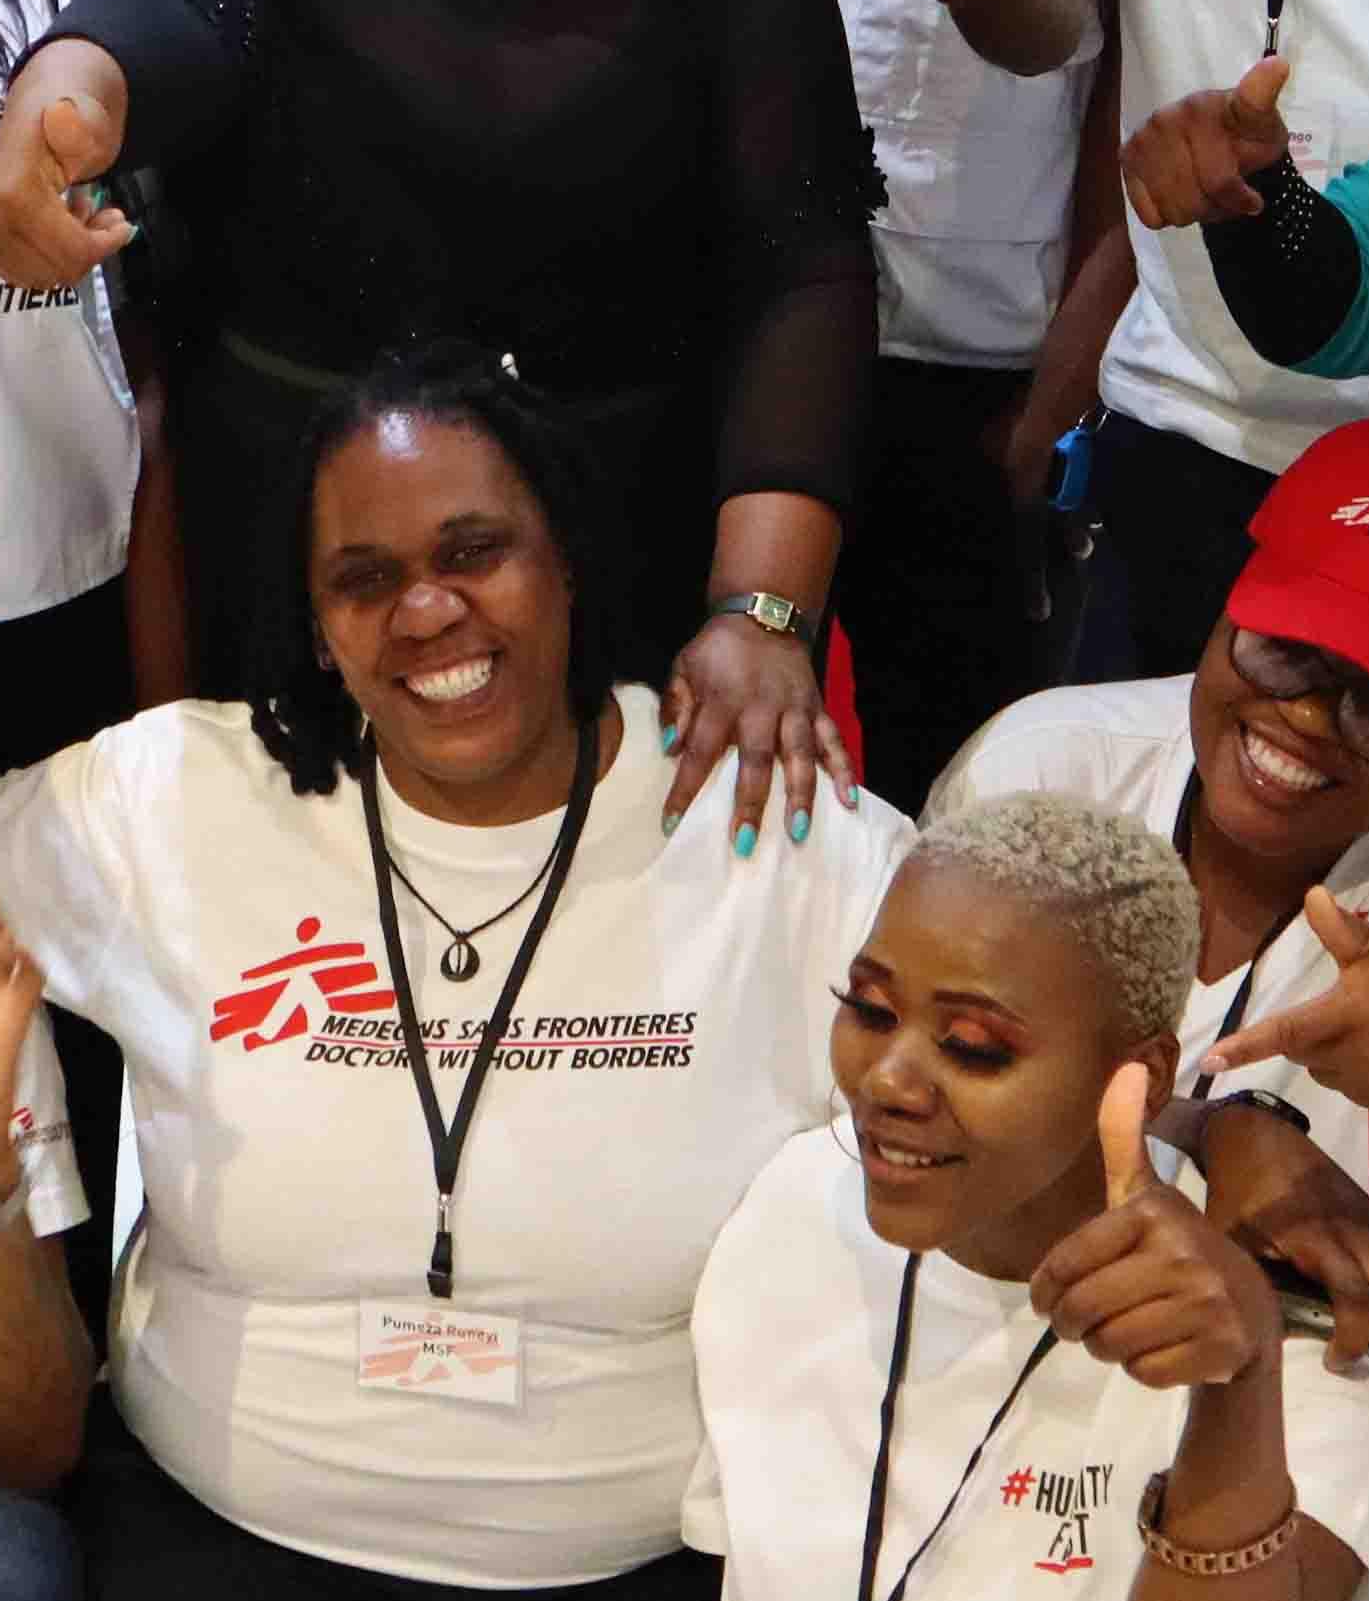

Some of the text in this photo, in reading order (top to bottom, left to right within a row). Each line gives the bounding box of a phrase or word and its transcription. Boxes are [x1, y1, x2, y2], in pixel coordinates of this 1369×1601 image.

[322, 1011, 698, 1041] MEDECNS SAS FRONTIERES
[305, 1041, 412, 1070] DOCTOR
[570, 1043, 695, 1071] BORDERS
[423, 1341, 457, 1358] MSF
